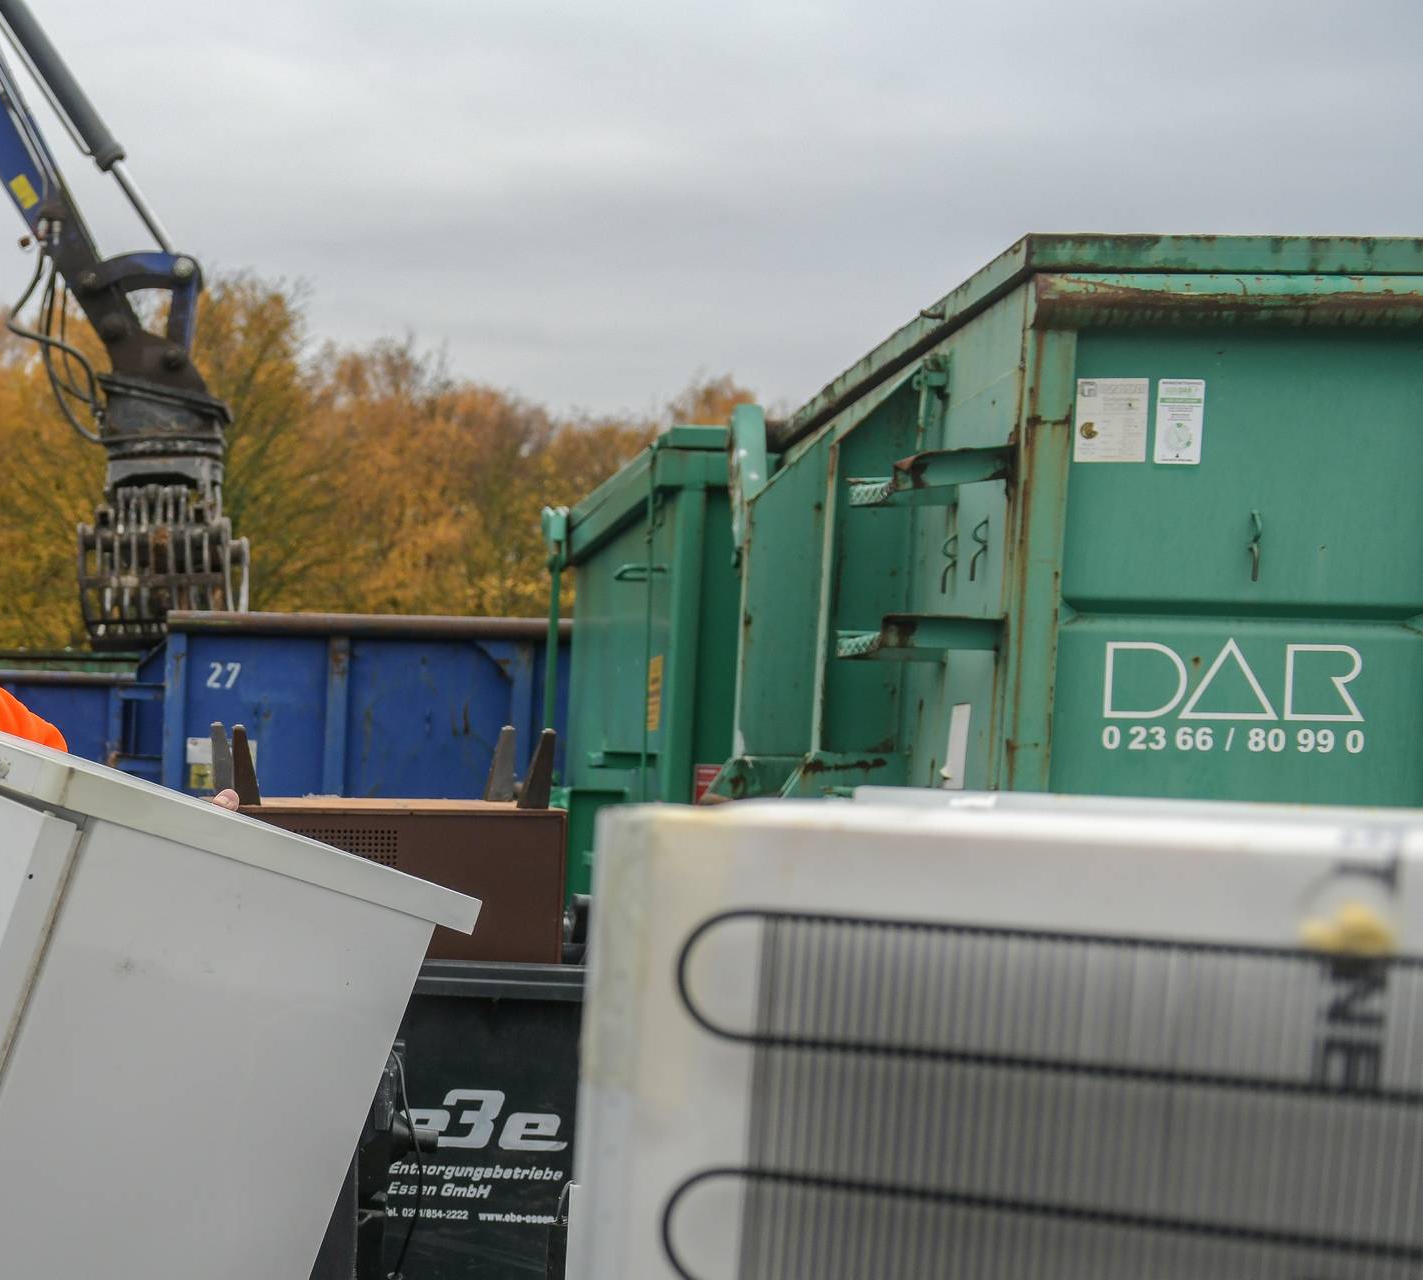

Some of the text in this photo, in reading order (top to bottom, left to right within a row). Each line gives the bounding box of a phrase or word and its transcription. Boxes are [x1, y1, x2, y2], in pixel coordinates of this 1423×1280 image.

[206, 661, 241, 689] 27
[1103, 637, 1365, 722] DAR
[1102, 726, 1121, 749] 0
[1128, 726, 1167, 750] 23
[1176, 727, 1213, 750] 66
[1247, 728, 1286, 752] 80
[1296, 729, 1335, 753] 99
[1345, 729, 1365, 754] 0
[440, 1182, 492, 1199] GmbH
[402, 1207, 469, 1220] 021/854-2222
